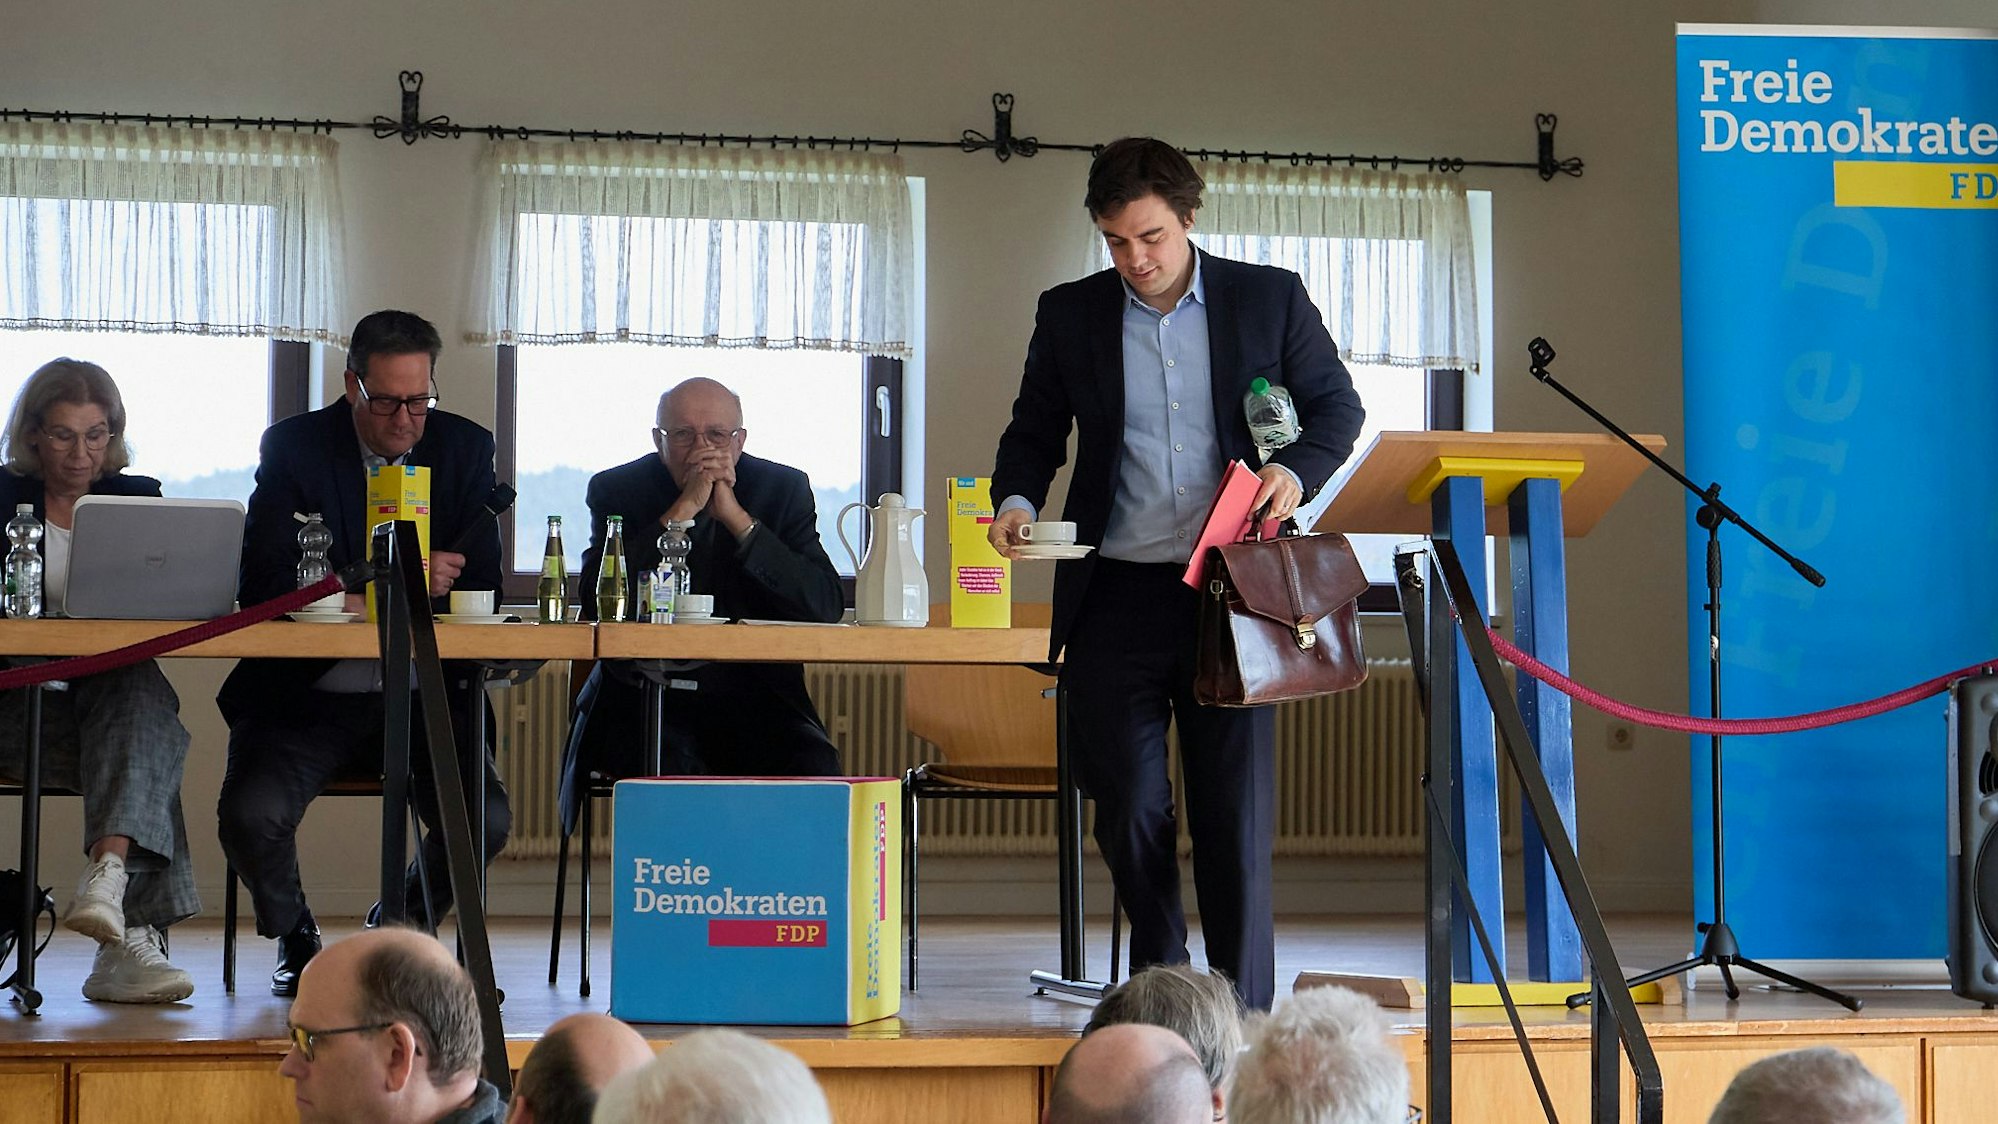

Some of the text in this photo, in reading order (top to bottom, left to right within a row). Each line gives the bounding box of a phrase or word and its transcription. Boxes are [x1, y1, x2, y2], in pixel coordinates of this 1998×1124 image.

[1699, 59, 1832, 104] Freie
[634, 858, 710, 885] Freie
[633, 887, 827, 916] Demokraten
[776, 925, 820, 943] FDP
